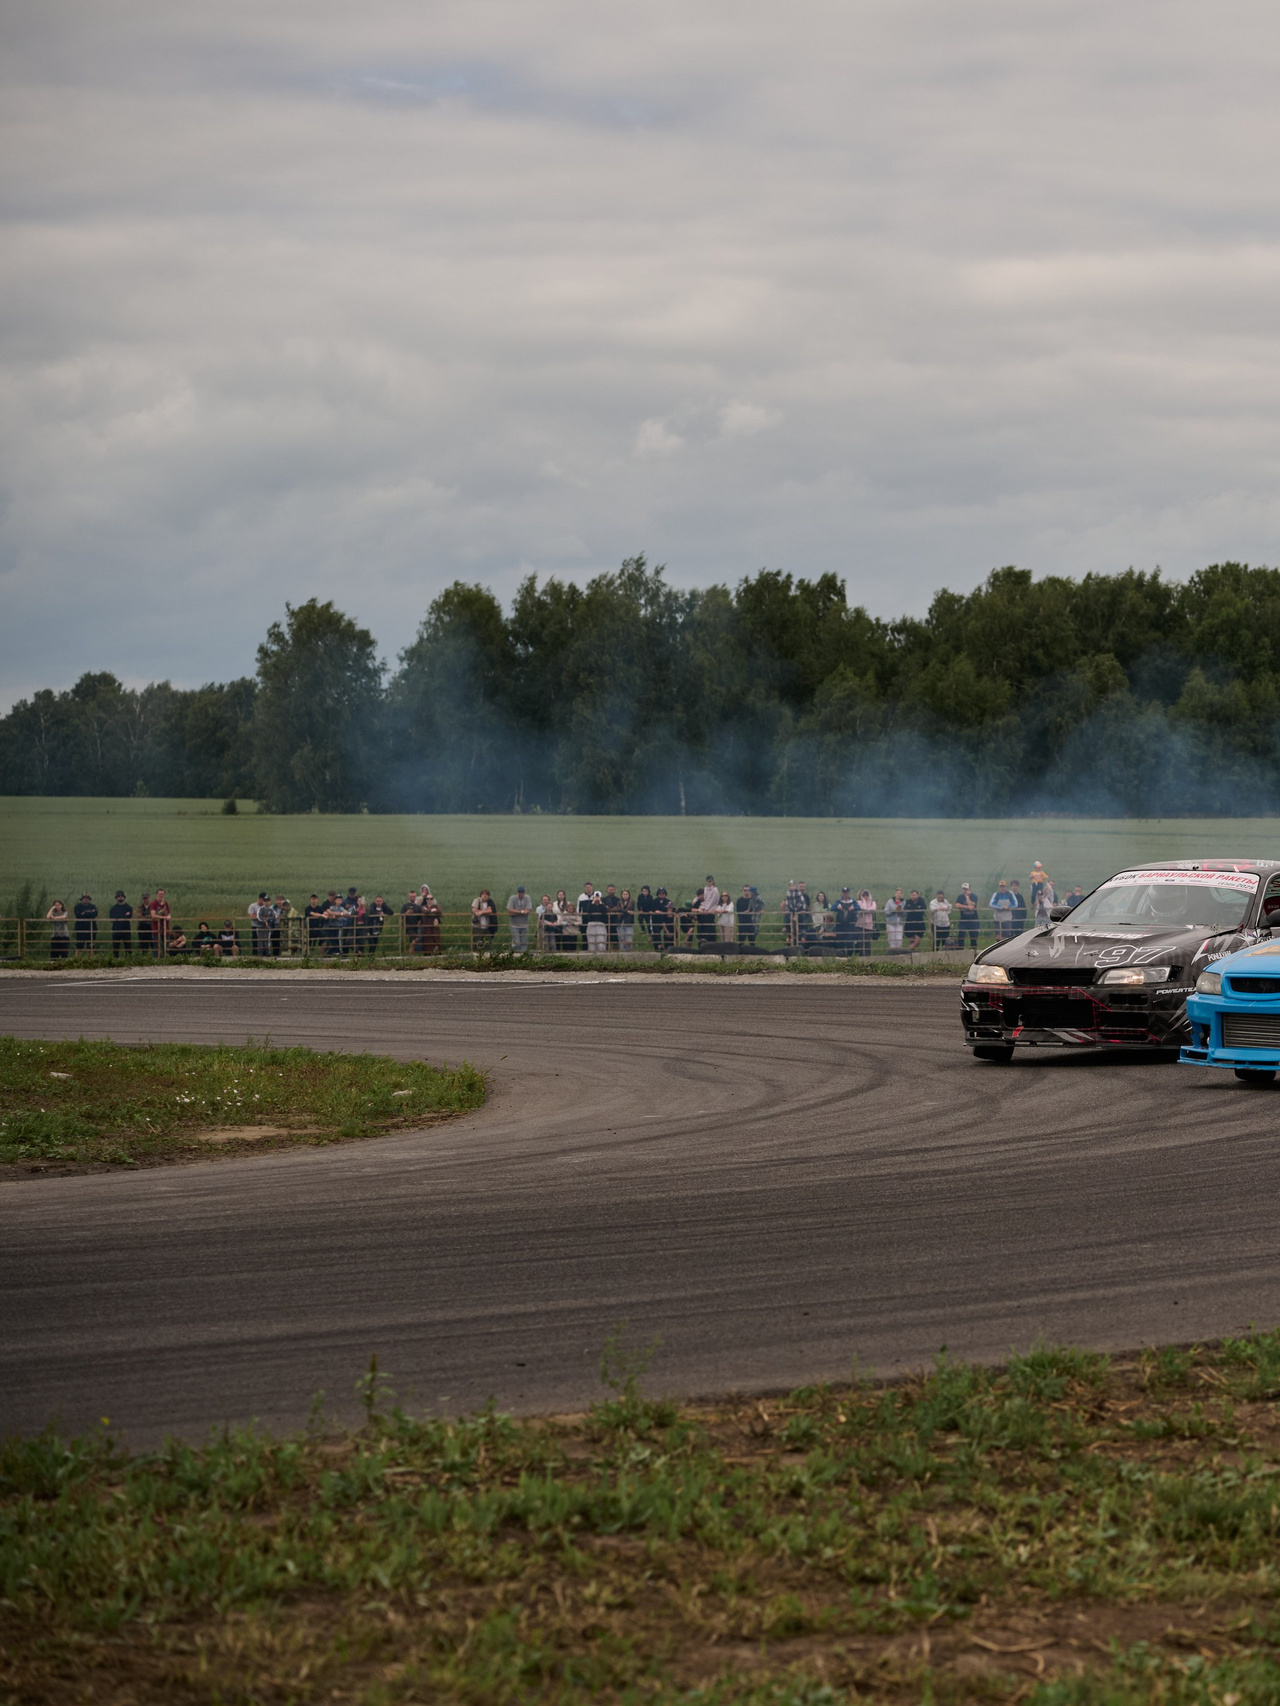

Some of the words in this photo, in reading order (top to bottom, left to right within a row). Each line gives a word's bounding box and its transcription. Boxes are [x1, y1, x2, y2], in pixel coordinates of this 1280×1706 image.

[1138, 871, 1214, 880] БАРНАУЛЬСКОЙ
[1215, 873, 1258, 885] РАКЕТЫ
[1094, 945, 1177, 968] 97
